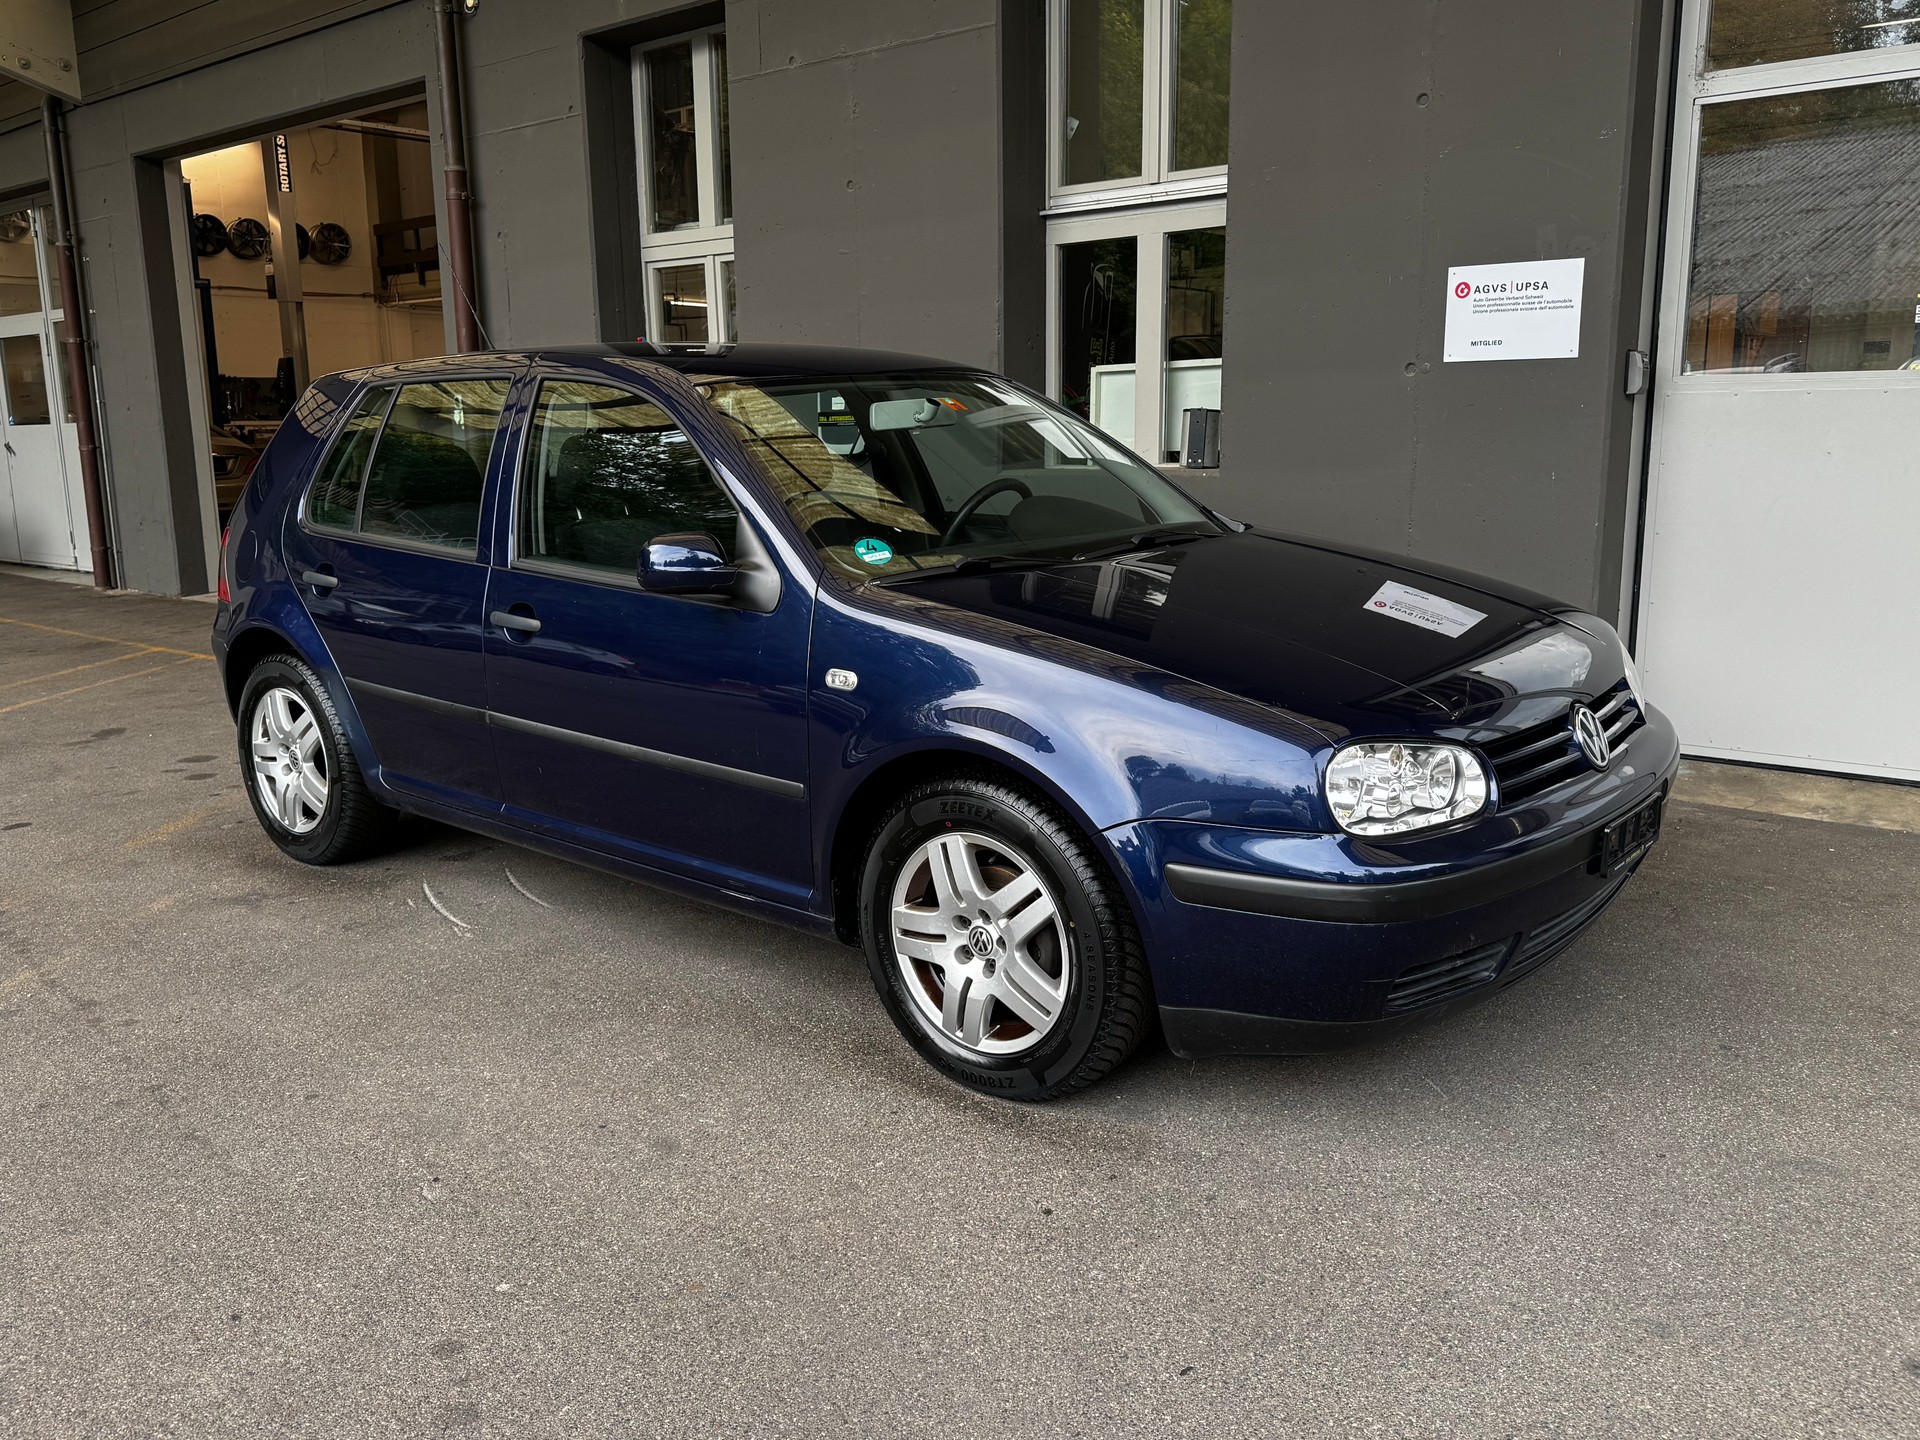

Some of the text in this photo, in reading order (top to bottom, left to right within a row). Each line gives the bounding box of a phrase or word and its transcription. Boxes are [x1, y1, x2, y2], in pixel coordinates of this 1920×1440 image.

[277, 146, 290, 192] ROTARY
[1473, 281, 1549, 294] AGVS UPSA
[1470, 339, 1503, 347] MITGLIED
[938, 800, 1000, 822] ZEETEX
[1085, 945, 1096, 1012] SEASONS
[960, 1068, 1017, 1089] ZT8000
